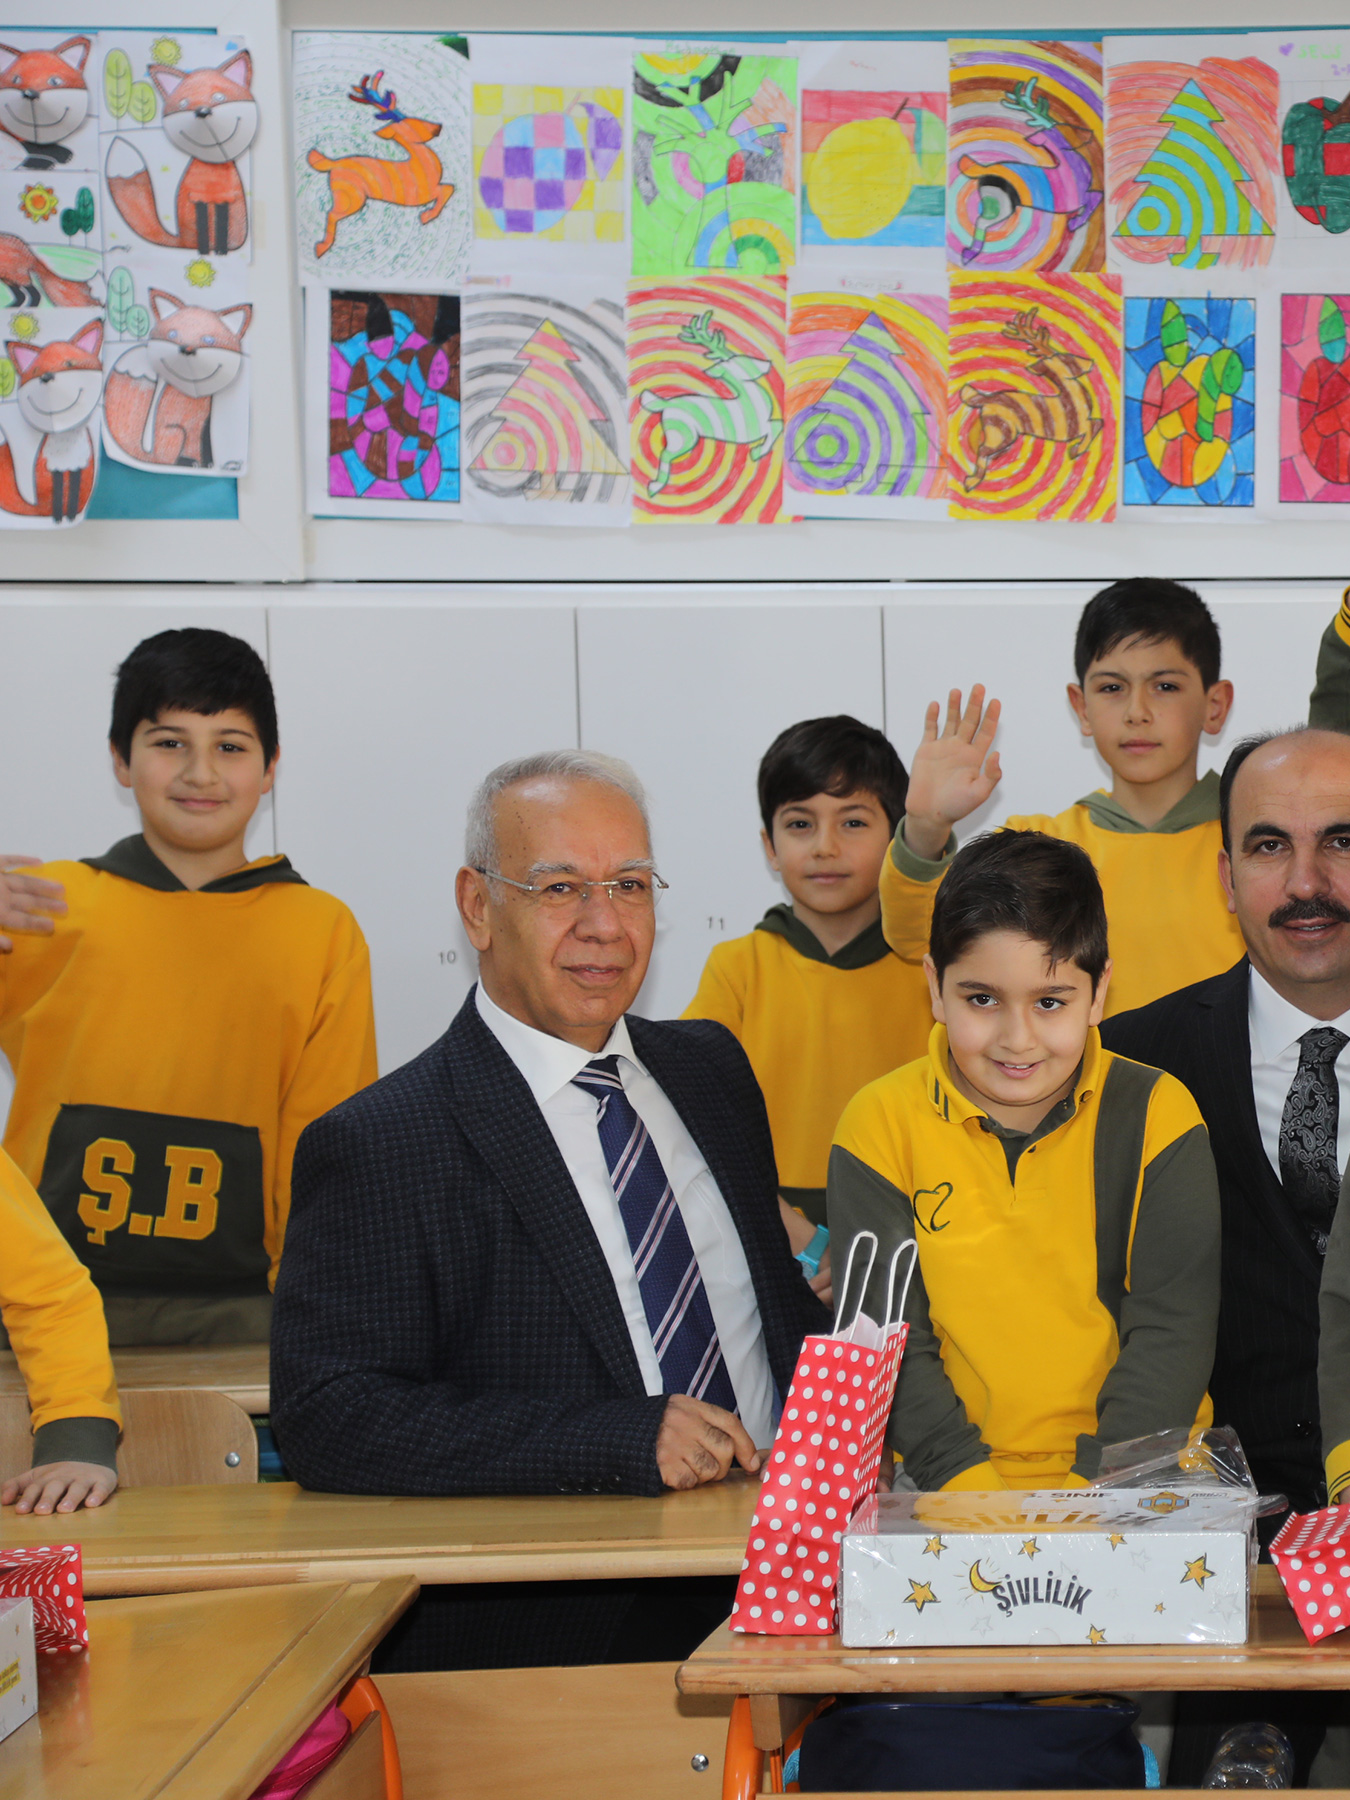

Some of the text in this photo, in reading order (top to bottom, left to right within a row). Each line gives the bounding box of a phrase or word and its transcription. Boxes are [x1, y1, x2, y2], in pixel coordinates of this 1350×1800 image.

[706, 916, 726, 931] 11
[437, 950, 457, 965] 10
[77, 1137, 223, 1246] Ş.B
[995, 1570, 1093, 1618] ŞİVLİLİK
